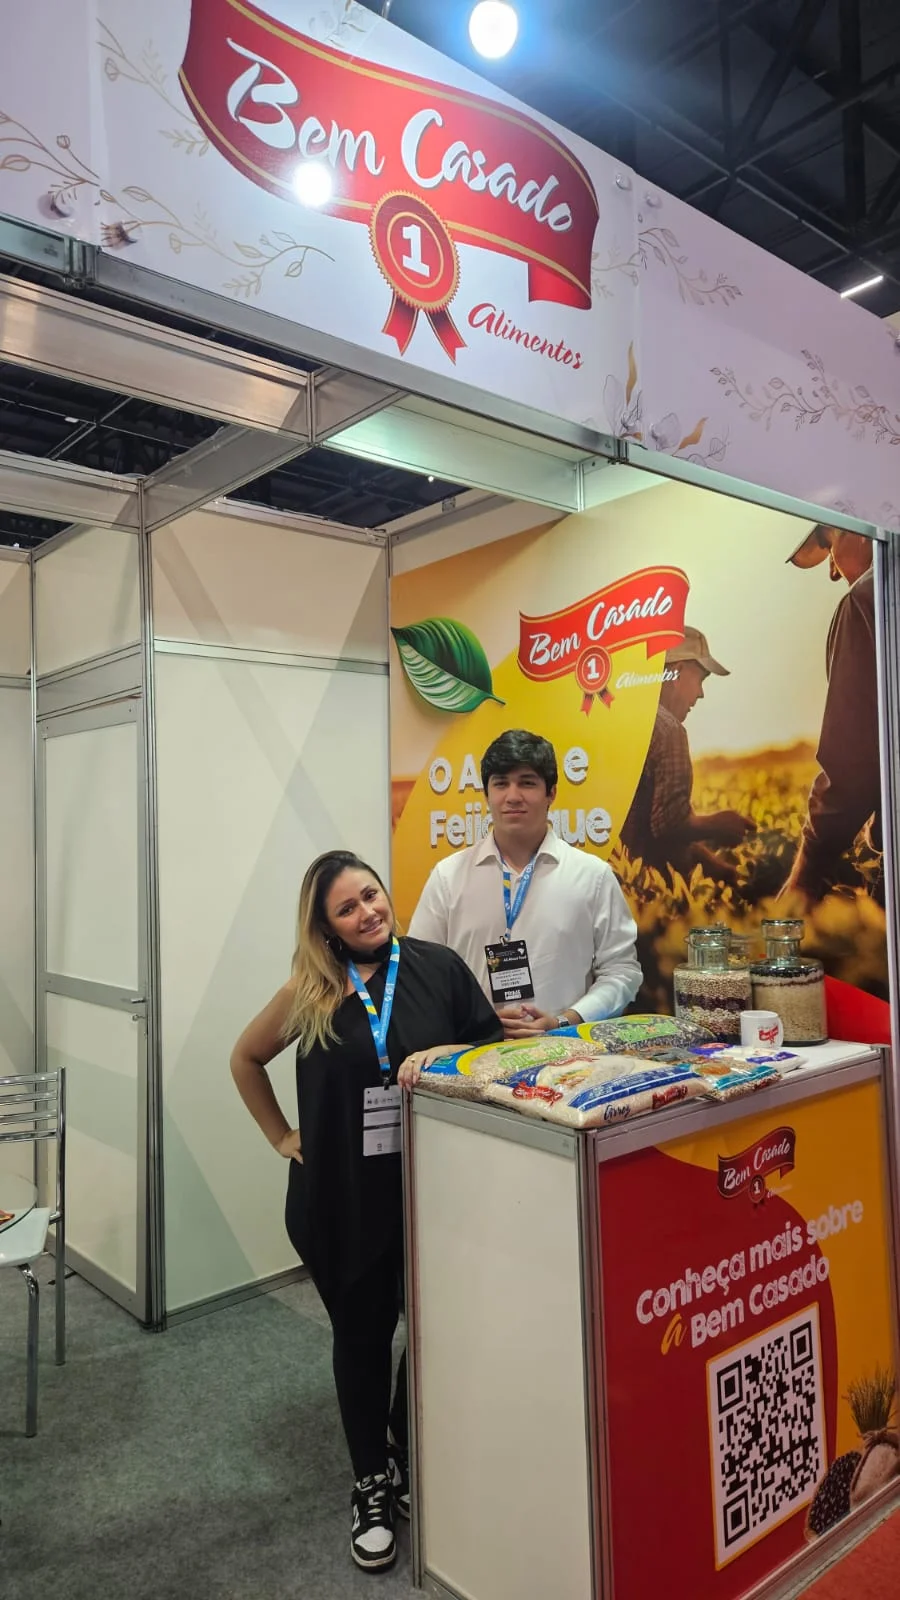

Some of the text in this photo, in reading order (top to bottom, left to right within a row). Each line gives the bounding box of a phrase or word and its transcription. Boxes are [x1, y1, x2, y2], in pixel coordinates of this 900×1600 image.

[226, 37, 573, 233] Bem Casado
[402, 224, 430, 277] 1
[467, 302, 584, 370] Alimentos
[529, 586, 673, 666] Bem Casado
[587, 658, 600, 680] 1
[615, 668, 681, 689] Alimentos
[429, 757, 451, 793] O
[563, 747, 589, 783] e
[723, 1138, 791, 1190] Bem Casado
[754, 1181, 761, 1195] 1
[636, 1200, 864, 1325] Conheça mais sobre
[660, 1256, 830, 1356] a Bem Casado
